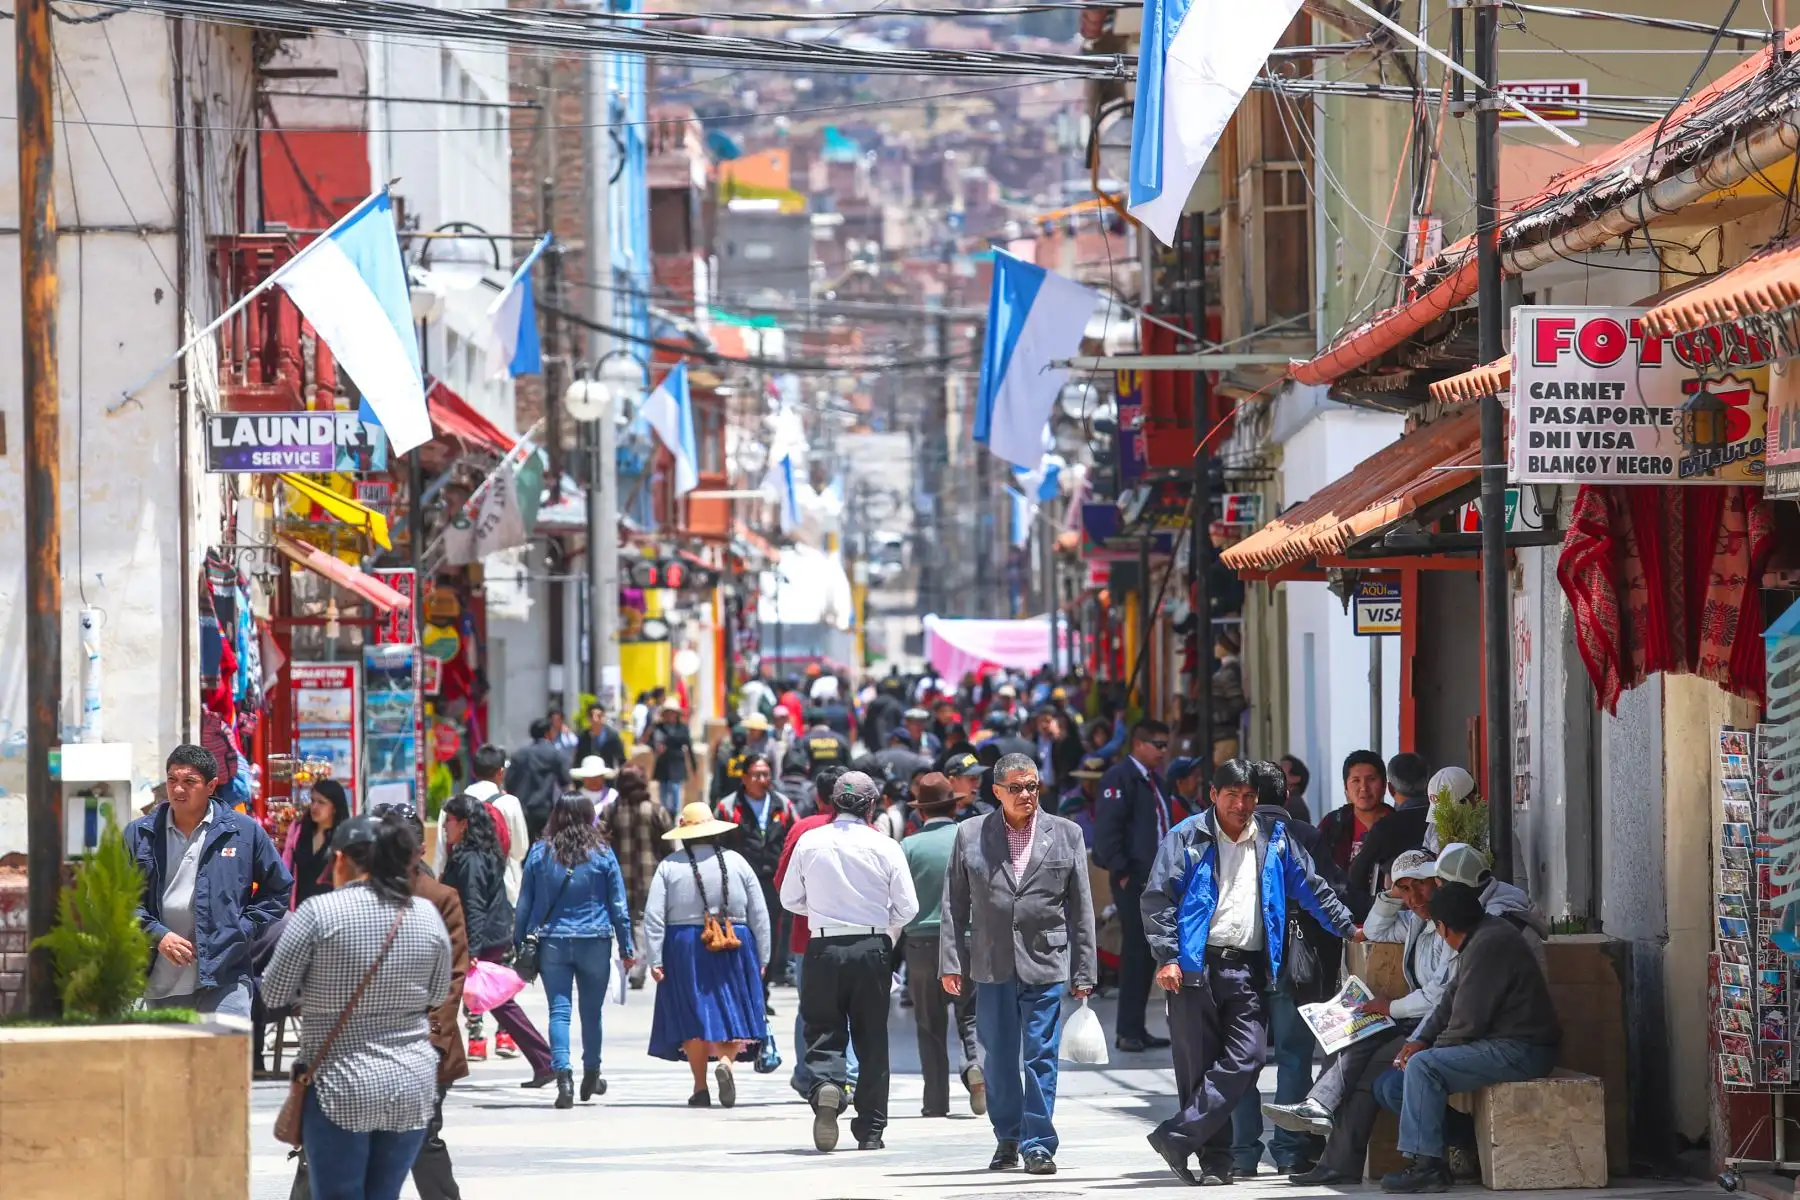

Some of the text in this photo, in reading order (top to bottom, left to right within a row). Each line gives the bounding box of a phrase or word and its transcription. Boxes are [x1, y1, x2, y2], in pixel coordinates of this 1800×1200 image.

[1529, 382, 1626, 400] CARNET
[1529, 407, 1674, 426] PASAPORTE
[1529, 432, 1635, 449] DNI VISA
[252, 451, 321, 466] SERVICE
[1528, 456, 1673, 475] BLANCO Y NEGRO
[1679, 437, 1767, 478] MINUTO
